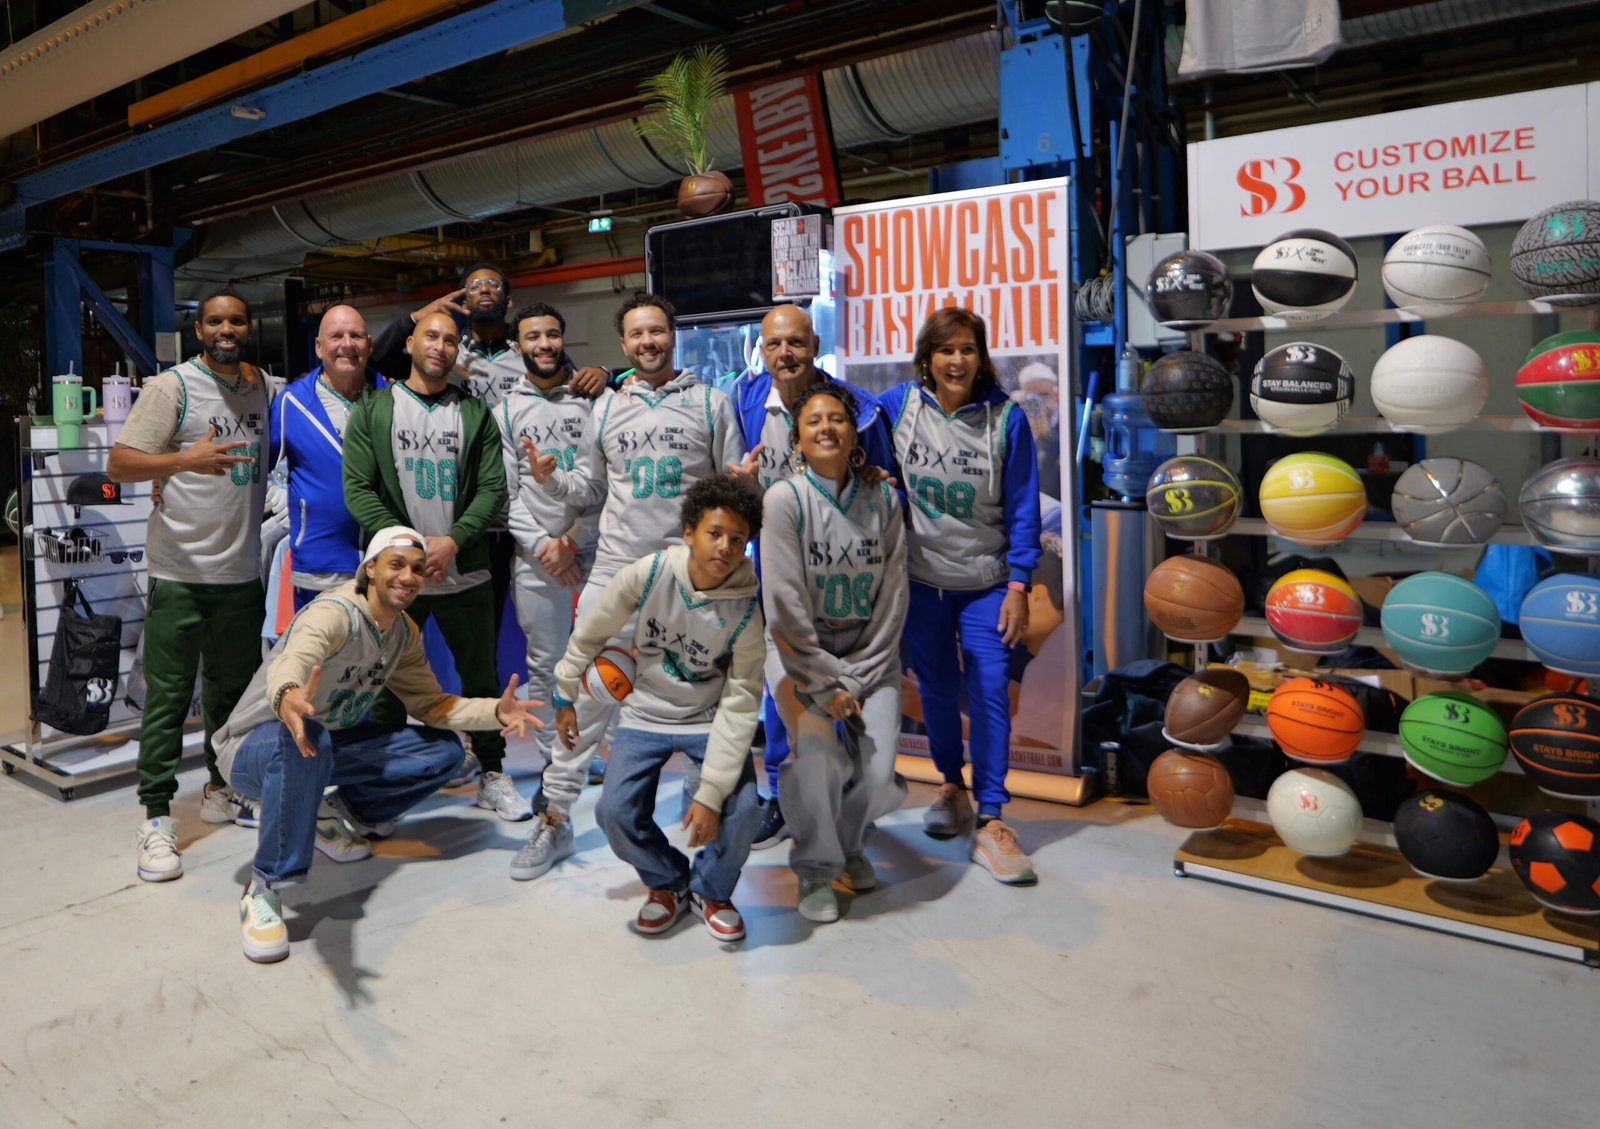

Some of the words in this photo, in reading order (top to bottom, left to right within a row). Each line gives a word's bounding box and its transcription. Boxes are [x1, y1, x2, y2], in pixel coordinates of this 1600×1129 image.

[1333, 127, 1536, 173] CUSTOMIZE
[1334, 171, 1430, 201] YOUR
[1442, 160, 1536, 190] BALL
[774, 219, 796, 236] SCAN
[774, 235, 789, 249] AND
[790, 233, 808, 247] WAIT
[843, 191, 1058, 297] SHOWCASE
[789, 247, 804, 260] FOR
[805, 246, 818, 259] THE
[786, 259, 818, 280] CLAW
[844, 283, 1059, 357] BASKBALL
[1262, 379, 1281, 389] STAY
[1282, 379, 1332, 391] BALANCED
[668, 442, 688, 450] NESS
[958, 449, 978, 458] SNEA
[952, 457, 968, 465] KER
[961, 467, 983, 476] NESS
[857, 548, 871, 556] KER
[1291, 700, 1316, 710] STAYS
[1317, 704, 1344, 718] BRIGHT
[1448, 743, 1481, 756] BRIGHT
[1533, 743, 1564, 757] STAYS
[1010, 750, 1062, 768] ASKETBALL.COM
